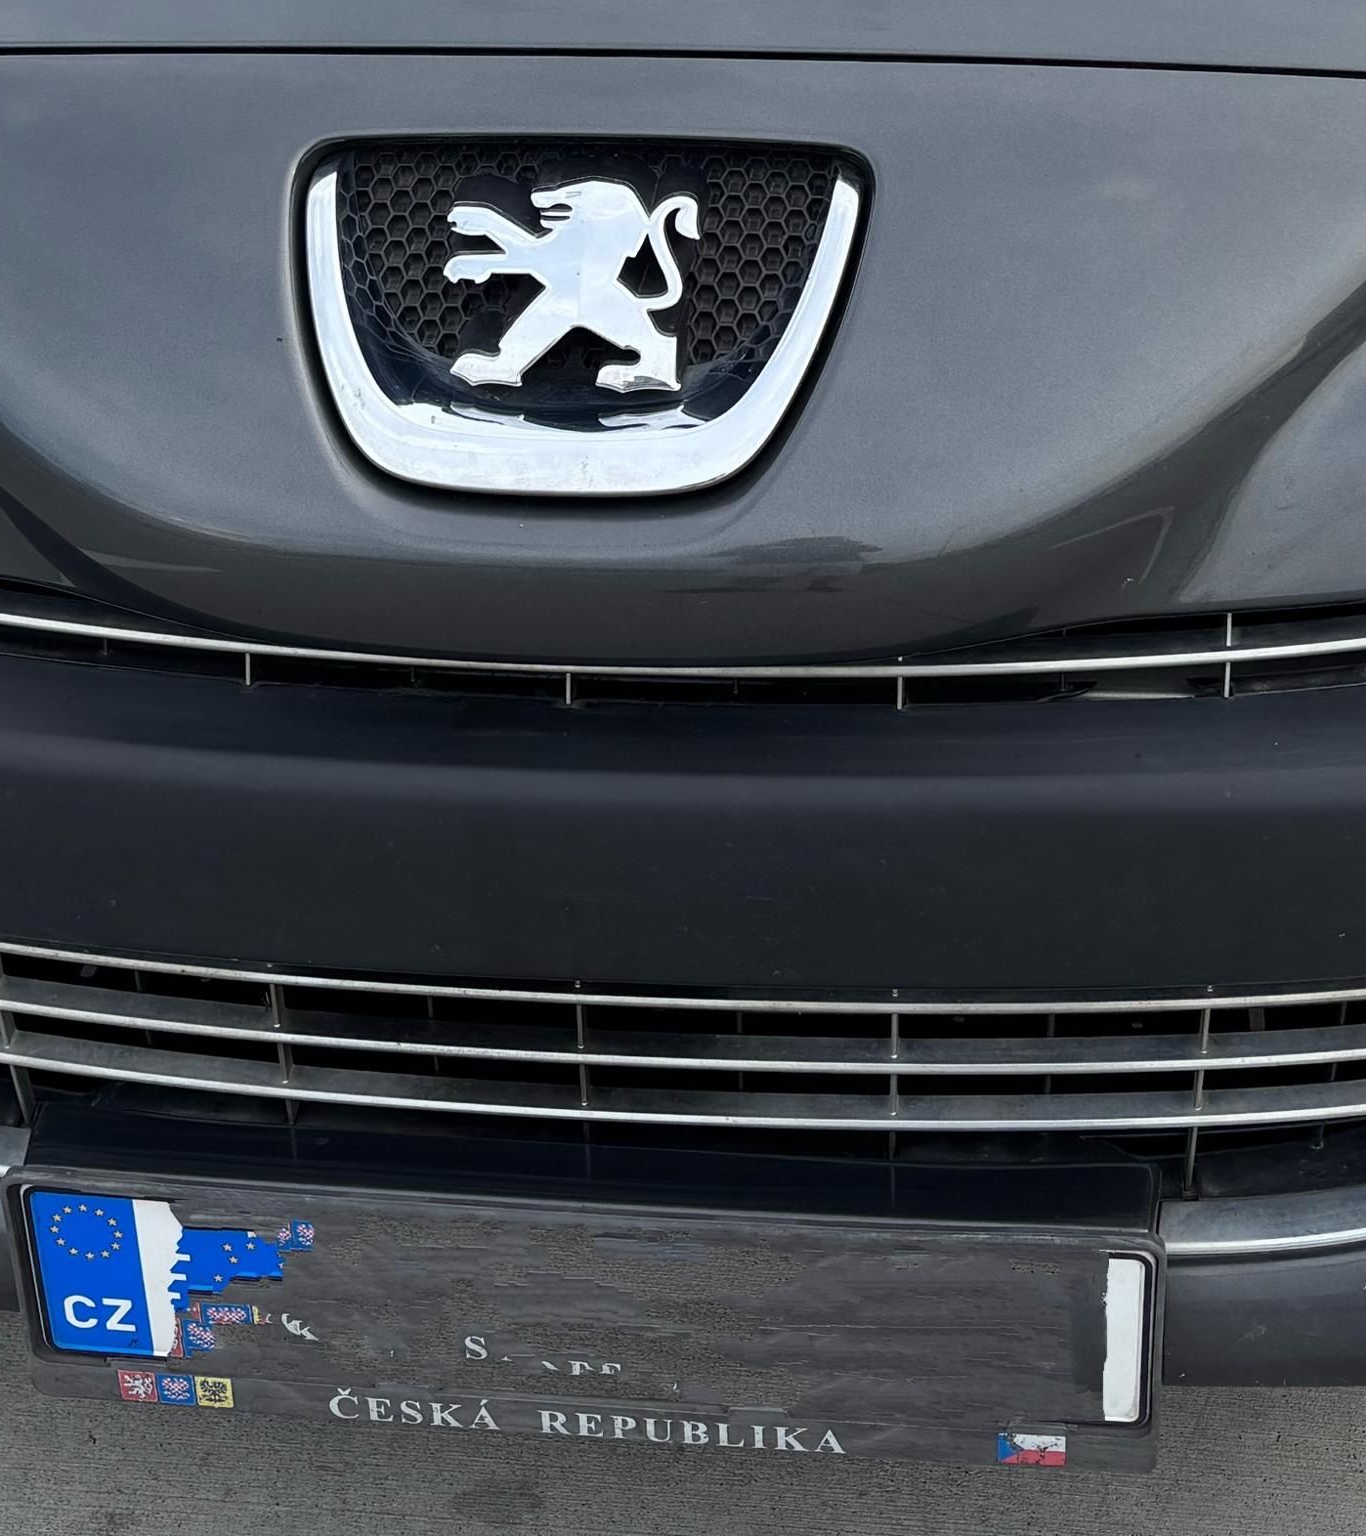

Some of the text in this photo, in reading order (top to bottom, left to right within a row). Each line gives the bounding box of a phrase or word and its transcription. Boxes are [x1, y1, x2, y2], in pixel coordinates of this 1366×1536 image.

[63, 1295, 136, 1332] CZ
[329, 1387, 846, 1455] ČESKÁ REPUBLIKA
